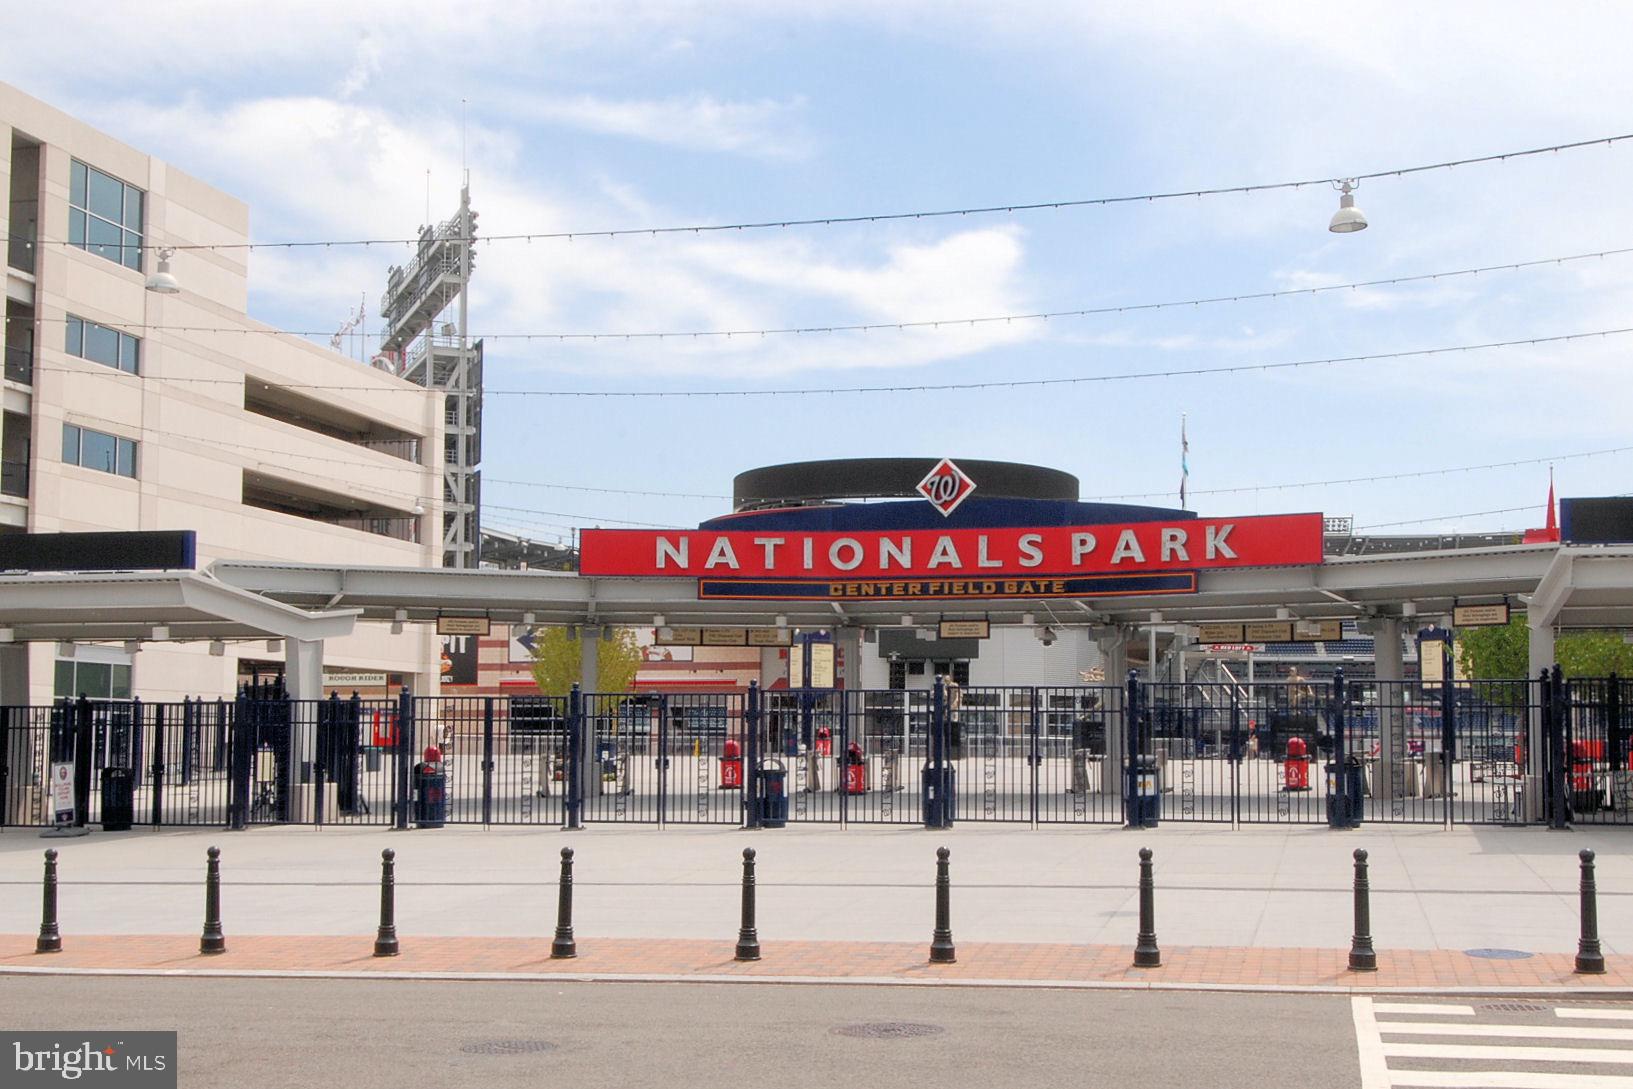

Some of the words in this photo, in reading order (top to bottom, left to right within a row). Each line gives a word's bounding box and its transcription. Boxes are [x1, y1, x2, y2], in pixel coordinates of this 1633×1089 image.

[655, 533, 1044, 571] NATIONALS
[1073, 524, 1239, 566] PARK
[829, 582, 924, 596] CENTER
[928, 581, 997, 595] FIELD
[1003, 580, 1066, 594] GATE
